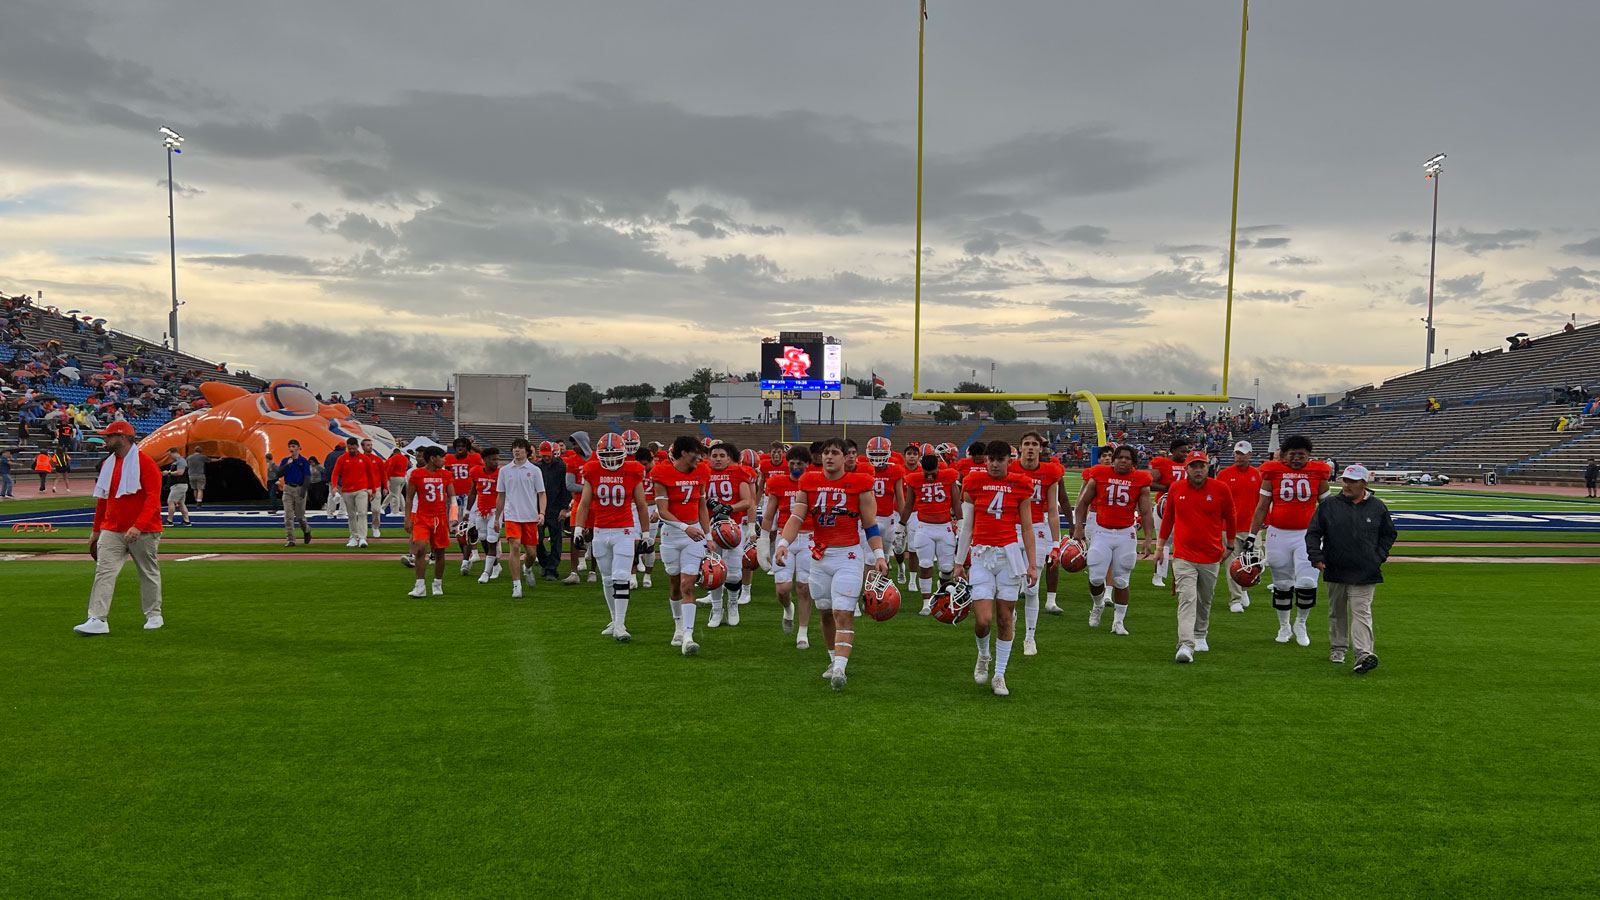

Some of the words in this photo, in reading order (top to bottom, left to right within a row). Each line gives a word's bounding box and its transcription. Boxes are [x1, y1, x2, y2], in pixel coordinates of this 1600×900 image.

[482, 481, 492, 495] 2
[600, 476, 624, 484] BOBCATS
[982, 485, 1013, 493] BOBCATS
[1107, 478, 1132, 487] BOBCATS
[424, 483, 445, 502] 31
[597, 484, 626, 507] 90
[681, 485, 694, 505] 7
[707, 480, 733, 502] 49
[921, 485, 947, 503] 35
[1105, 484, 1130, 507] 15
[1280, 478, 1312, 502] 60
[813, 491, 849, 513] 42
[986, 491, 1005, 520] 4
[817, 513, 837, 527] 42
